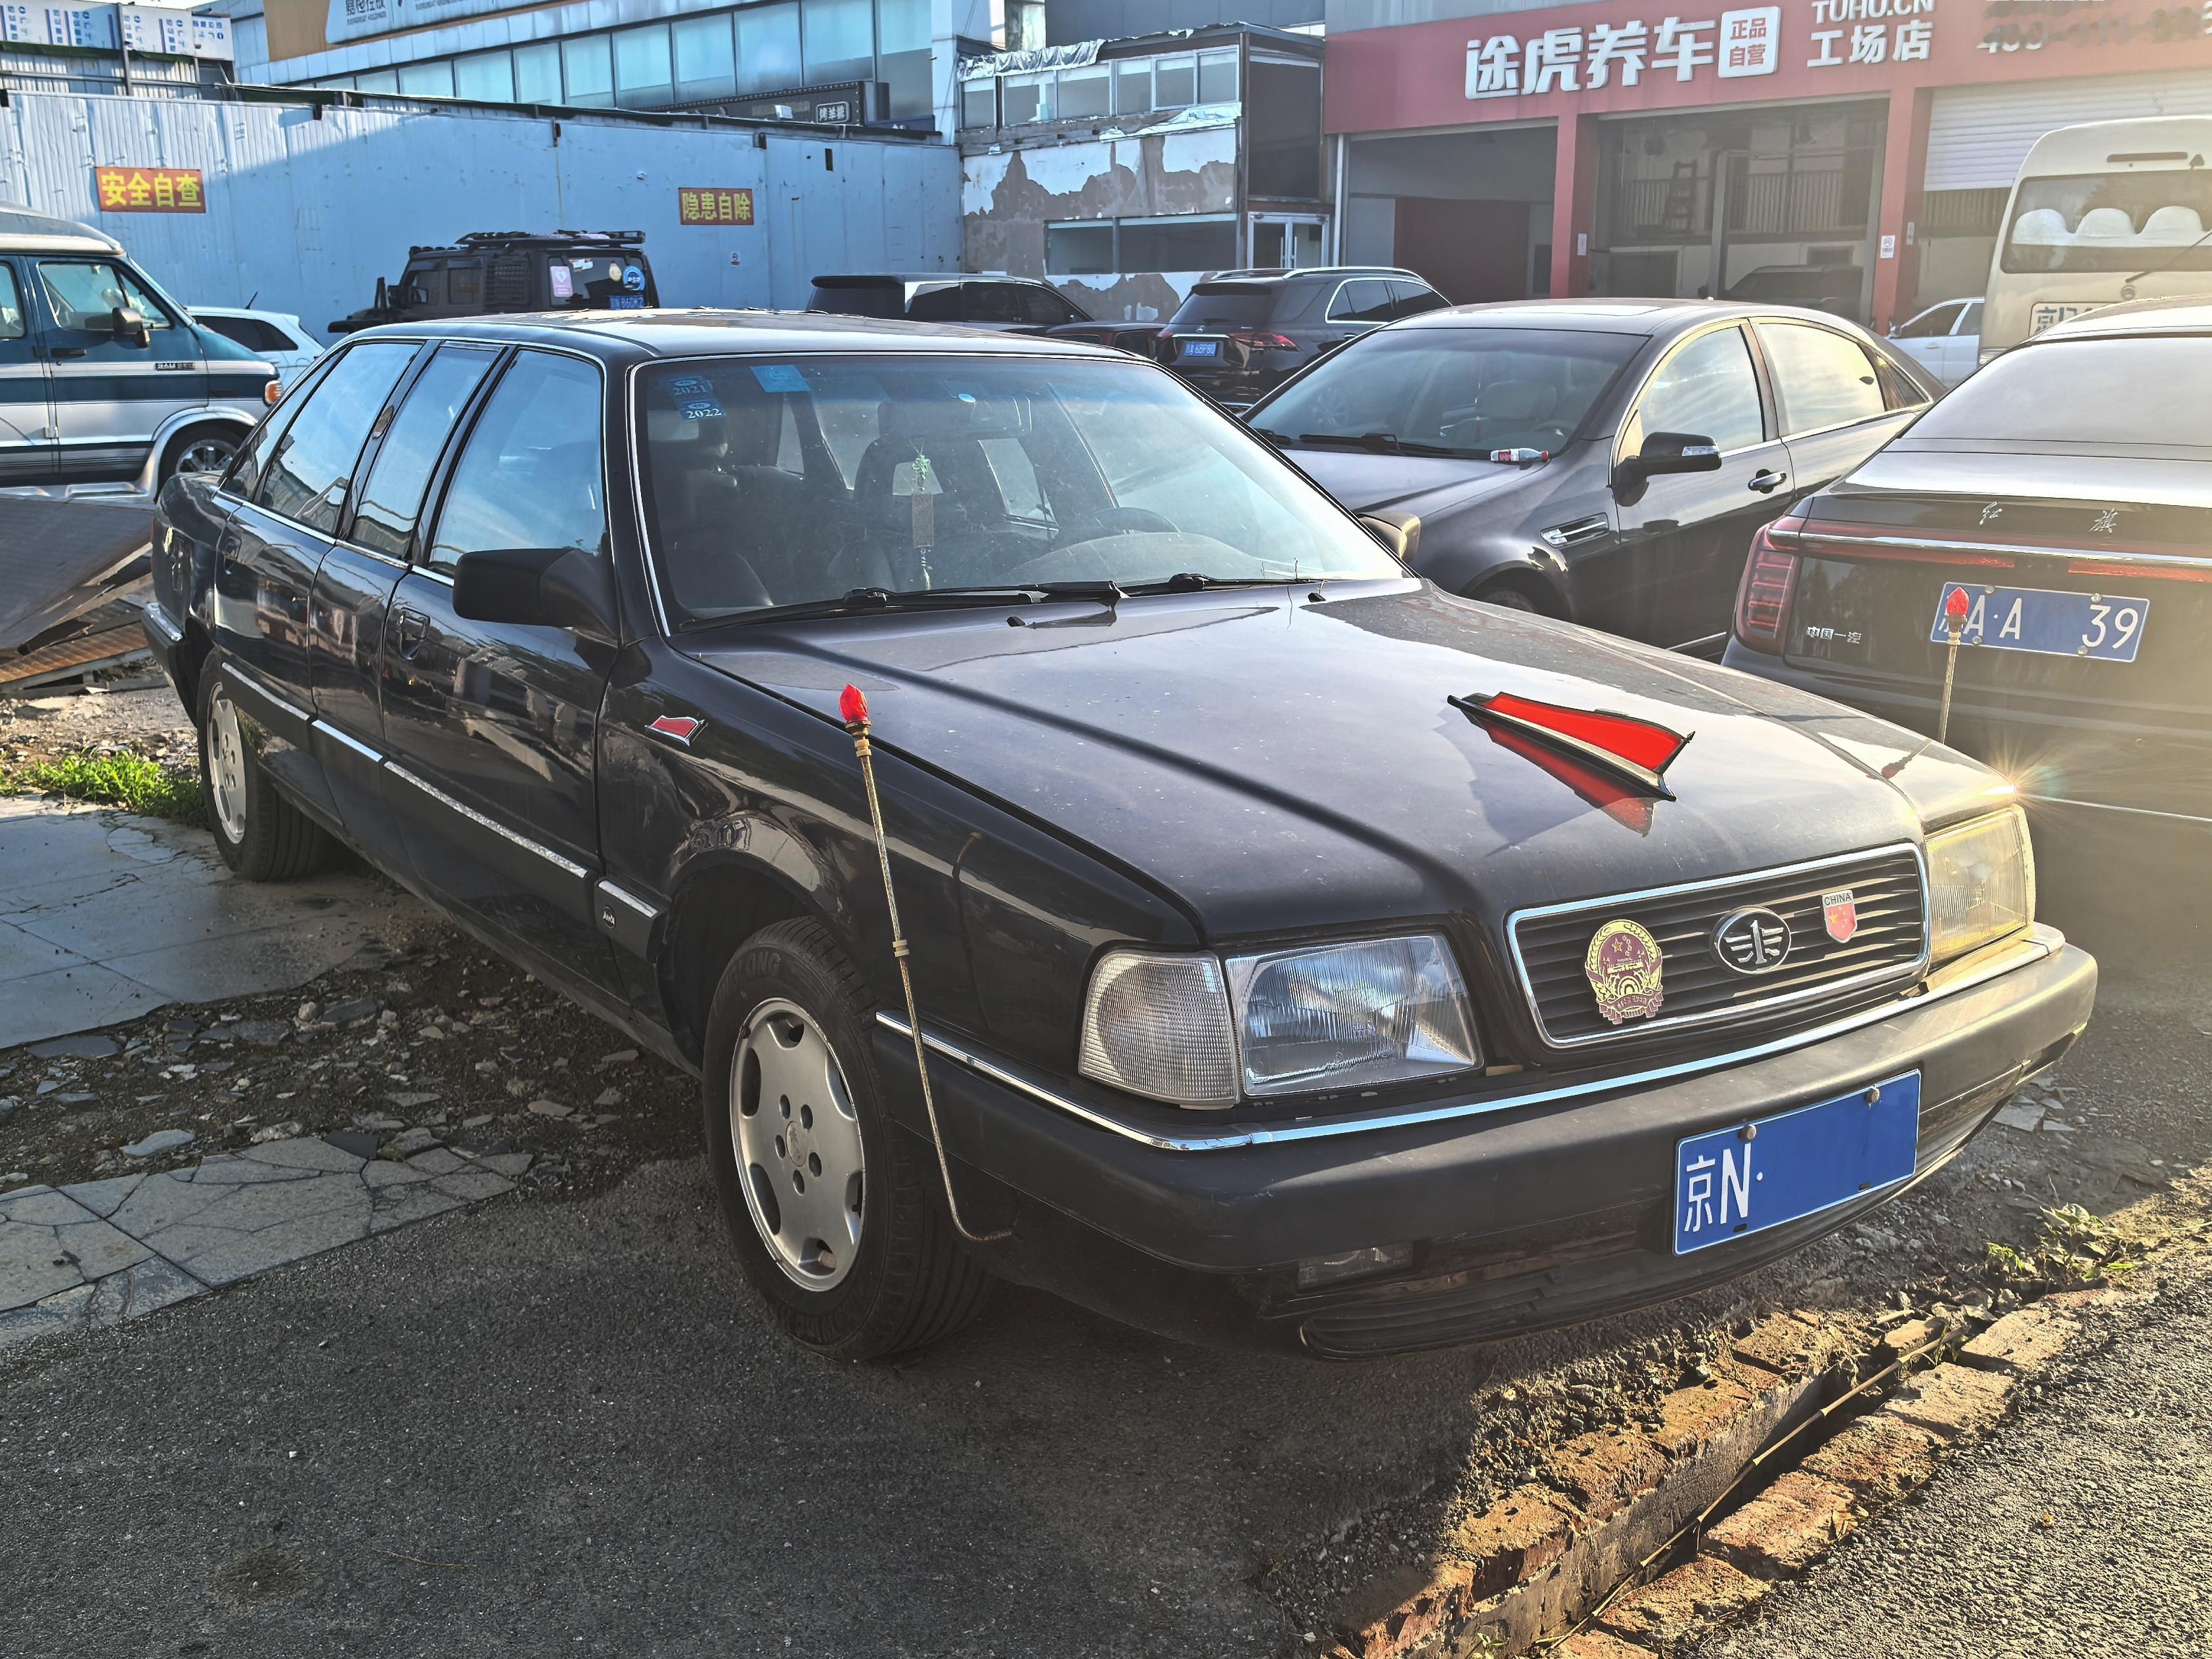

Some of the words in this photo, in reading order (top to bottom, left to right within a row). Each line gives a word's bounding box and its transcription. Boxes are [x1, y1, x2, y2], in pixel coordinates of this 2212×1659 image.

[1811, 0, 1936, 22] TUHU.CN
[1730, 17, 1767, 40] 正品
[1807, 19, 1934, 67] 工场店
[1465, 16, 1716, 99] 途虎养车
[1729, 43, 1766, 67] 自营
[102, 171, 200, 207] 安全自查
[682, 192, 751, 221] 隐患自除
[685, 409, 722, 418] 2022
[1807, 626, 1862, 644] 中国一汽
[1824, 892, 1853, 906] CHINA
